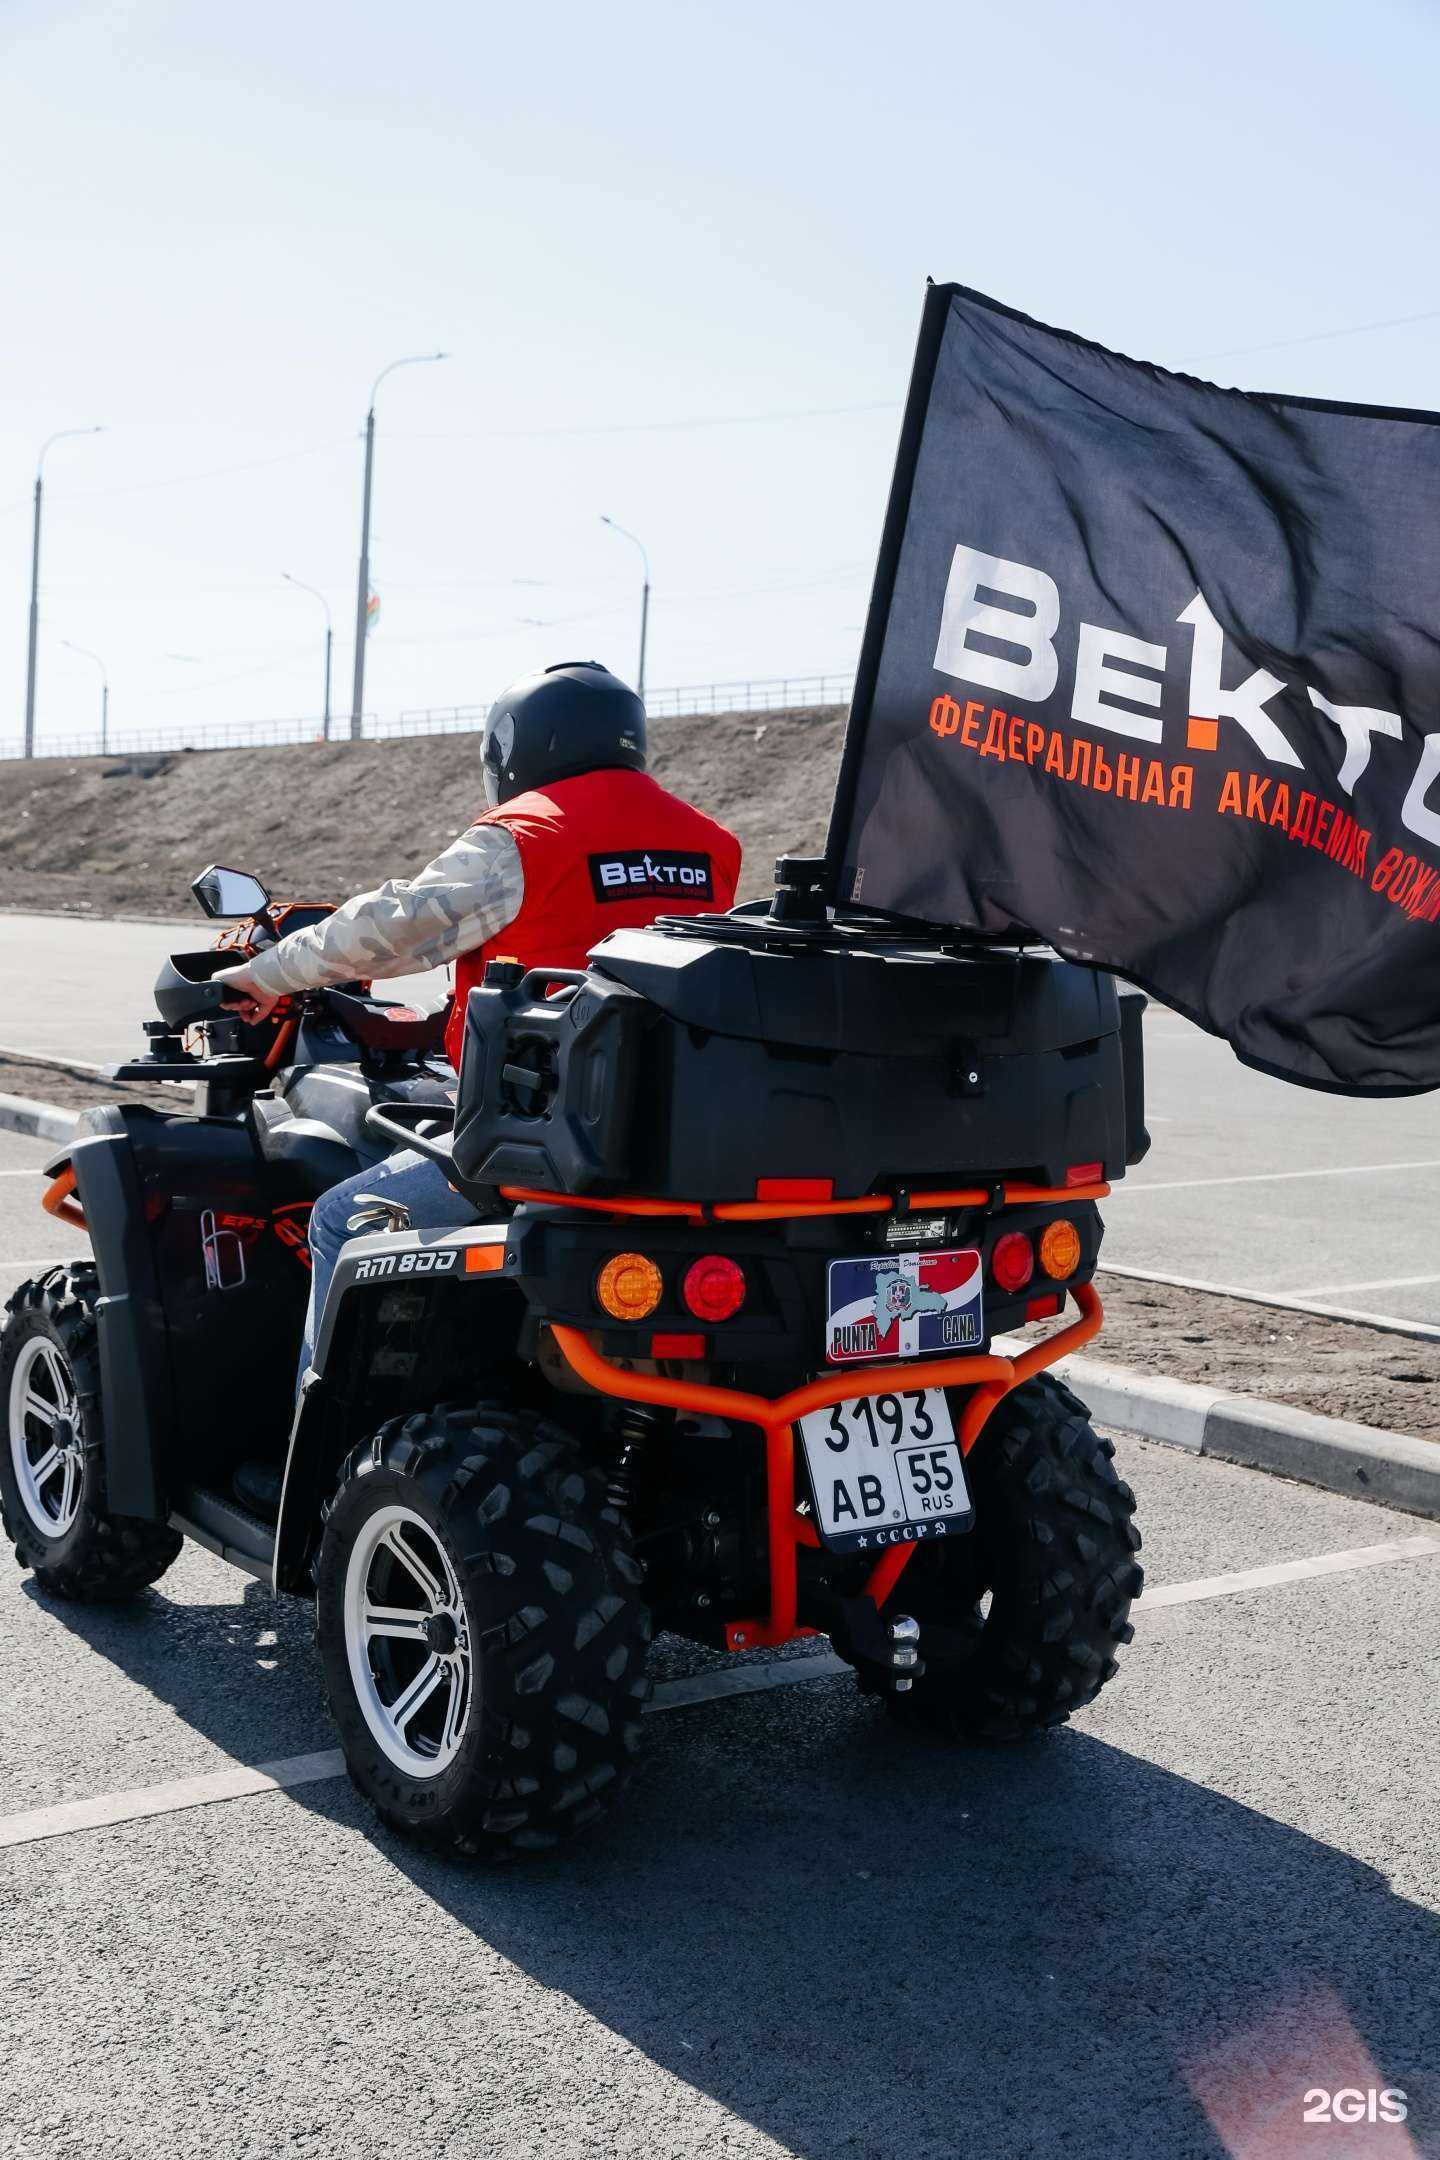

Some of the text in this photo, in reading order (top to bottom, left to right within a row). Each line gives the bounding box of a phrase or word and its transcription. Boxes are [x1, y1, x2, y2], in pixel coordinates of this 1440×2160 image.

[928, 694, 1194, 810] ФЕДЕРАЛЬНАЯ
[1217, 771, 1371, 879] АКАДЕМИЯ
[355, 1250, 458, 1280] RM 800
[832, 1314, 976, 1355] PUNTA CANA
[822, 1389, 934, 1453] 3193
[907, 1450, 954, 1495] 55
[921, 1494, 954, 1513] RUS
[876, 1524, 928, 1544] СССР
